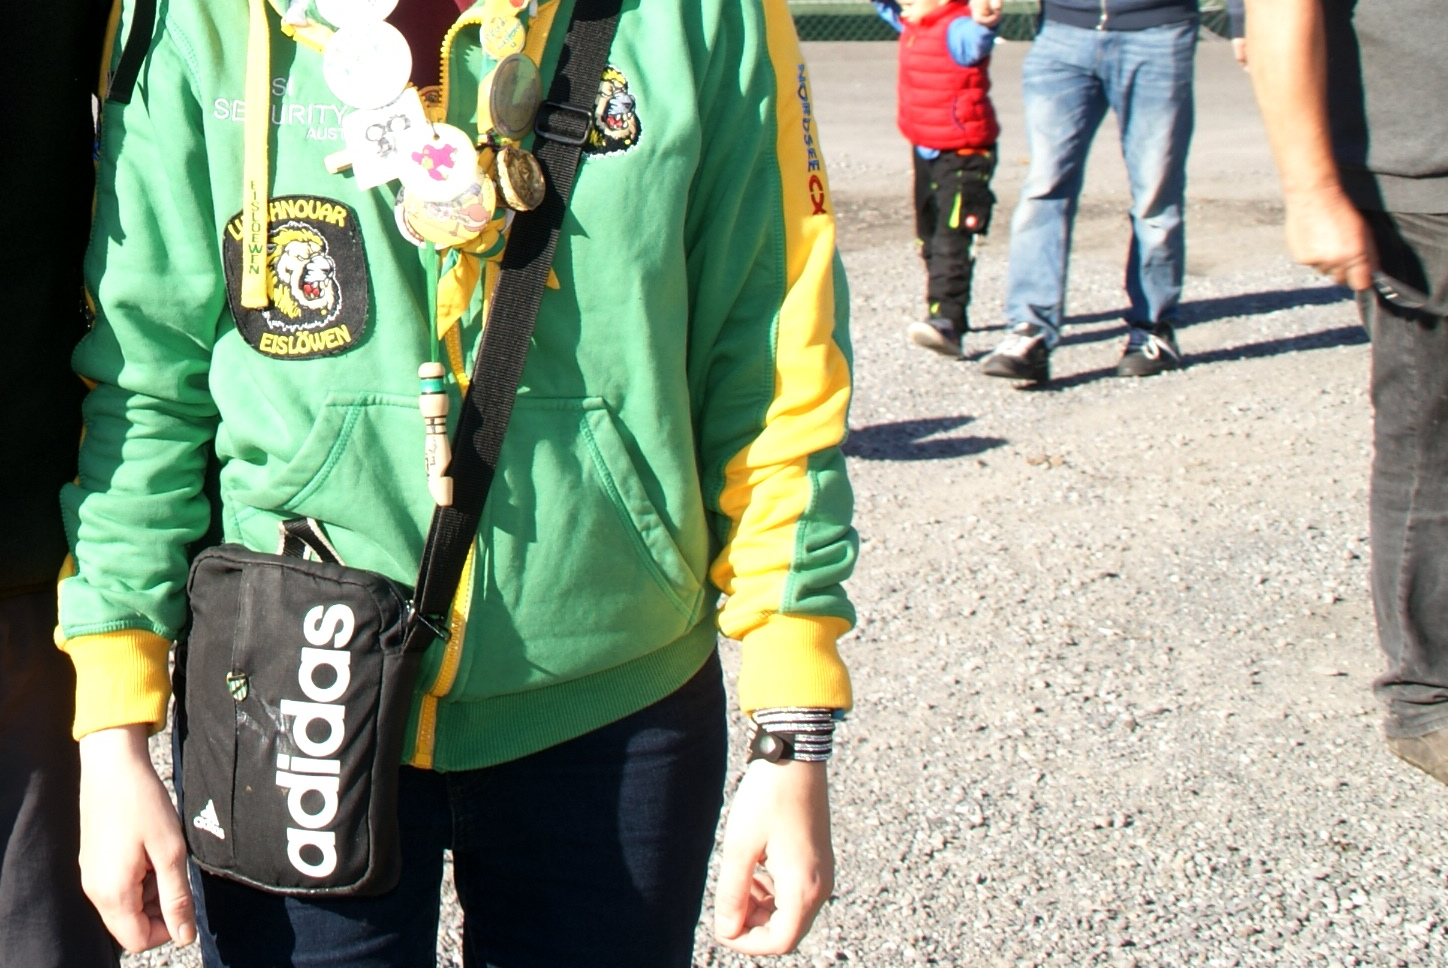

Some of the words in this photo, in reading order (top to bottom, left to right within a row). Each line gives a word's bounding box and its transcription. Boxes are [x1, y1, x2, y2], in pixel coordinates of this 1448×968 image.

[214, 98, 349, 125] SEURITY
[798, 63, 821, 172] NORDSEE
[247, 180, 263, 275] EISLOEWEN
[259, 324, 352, 355] EISLÖWEN
[275, 603, 355, 879] adidas
